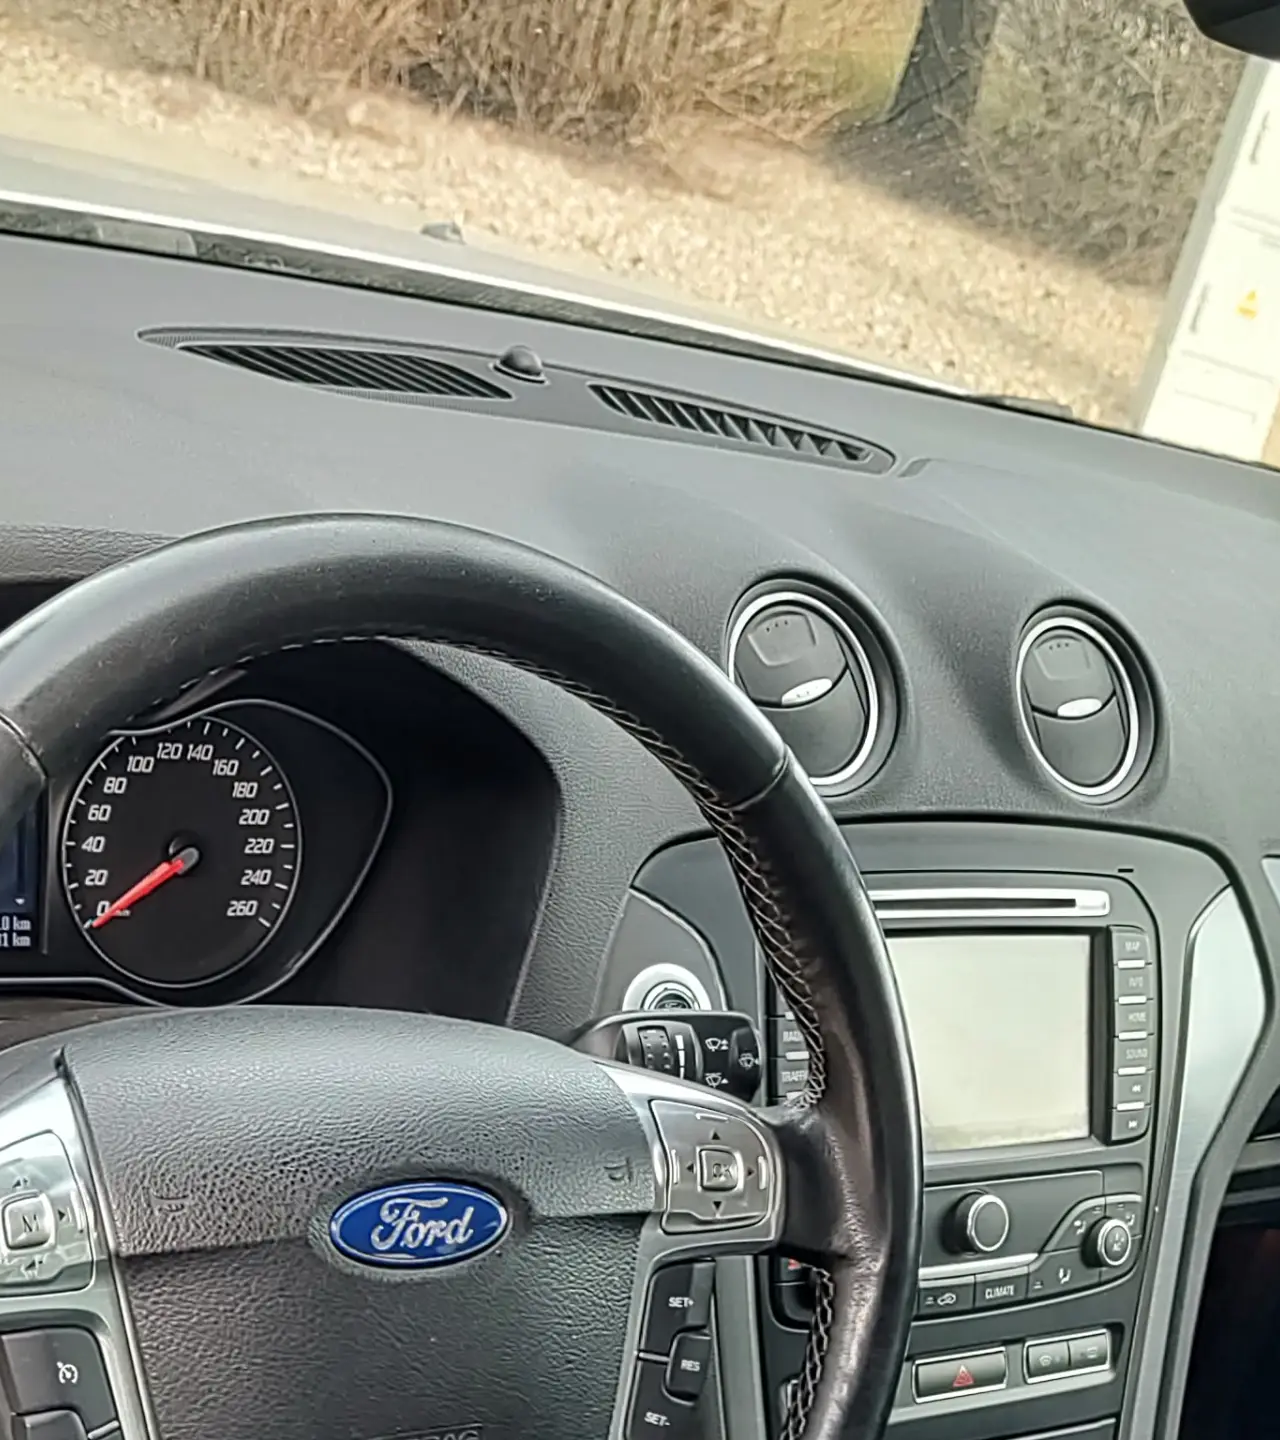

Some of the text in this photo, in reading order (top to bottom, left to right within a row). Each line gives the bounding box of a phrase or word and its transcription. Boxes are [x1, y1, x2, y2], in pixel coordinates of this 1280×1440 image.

[156, 742, 183, 761] 120
[186, 743, 214, 762] 140
[127, 754, 154, 774] 100
[212, 758, 239, 777] 160
[103, 777, 128, 795] 80
[231, 780, 258, 799] 180
[87, 804, 112, 822] 60
[238, 808, 270, 826] 200
[81, 835, 106, 854] 40
[244, 837, 275, 855] 220
[85, 868, 109, 887] 20
[240, 868, 272, 887] 240
[226, 900, 258, 918] 260
[12, 915, 32, 931] km
[12, 931, 32, 947] km
[370, 1197, 474, 1251] Ford
[985, 1285, 1014, 1299] CLIMATE
[680, 1359, 701, 1372] RES
